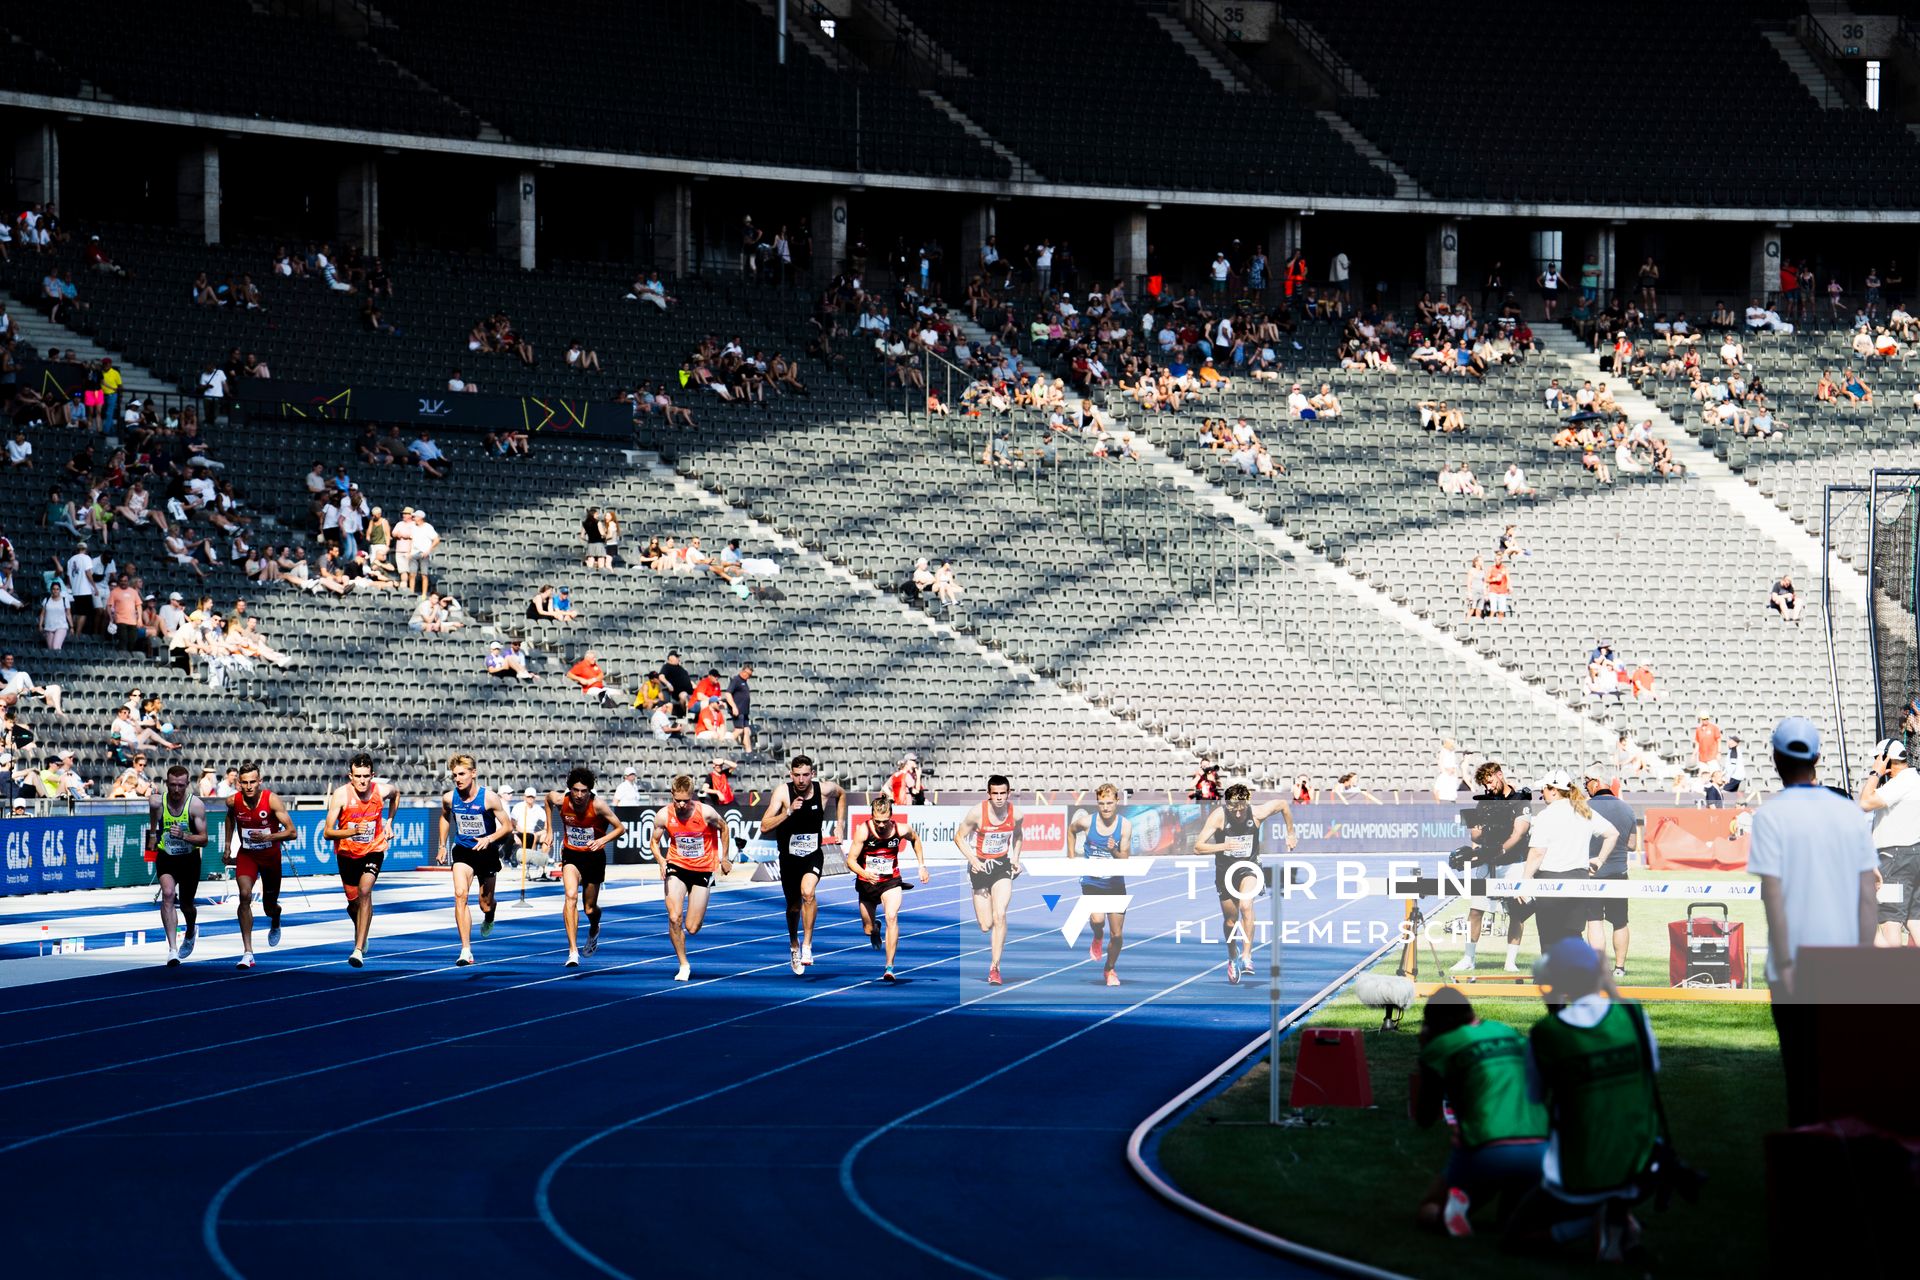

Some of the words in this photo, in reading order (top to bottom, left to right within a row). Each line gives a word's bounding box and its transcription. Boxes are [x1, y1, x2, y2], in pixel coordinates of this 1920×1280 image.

[1224, 7, 1244, 22] 35
[1842, 24, 1864, 39] 36
[523, 183, 533, 200] P
[834, 206, 846, 224] Q
[1443, 235, 1456, 252] Q
[1766, 241, 1779, 258] Q
[933, 822, 955, 841] sind
[1341, 823, 1418, 839] CHAMPIONSHIPS
[1421, 822, 1465, 839] MUNICH
